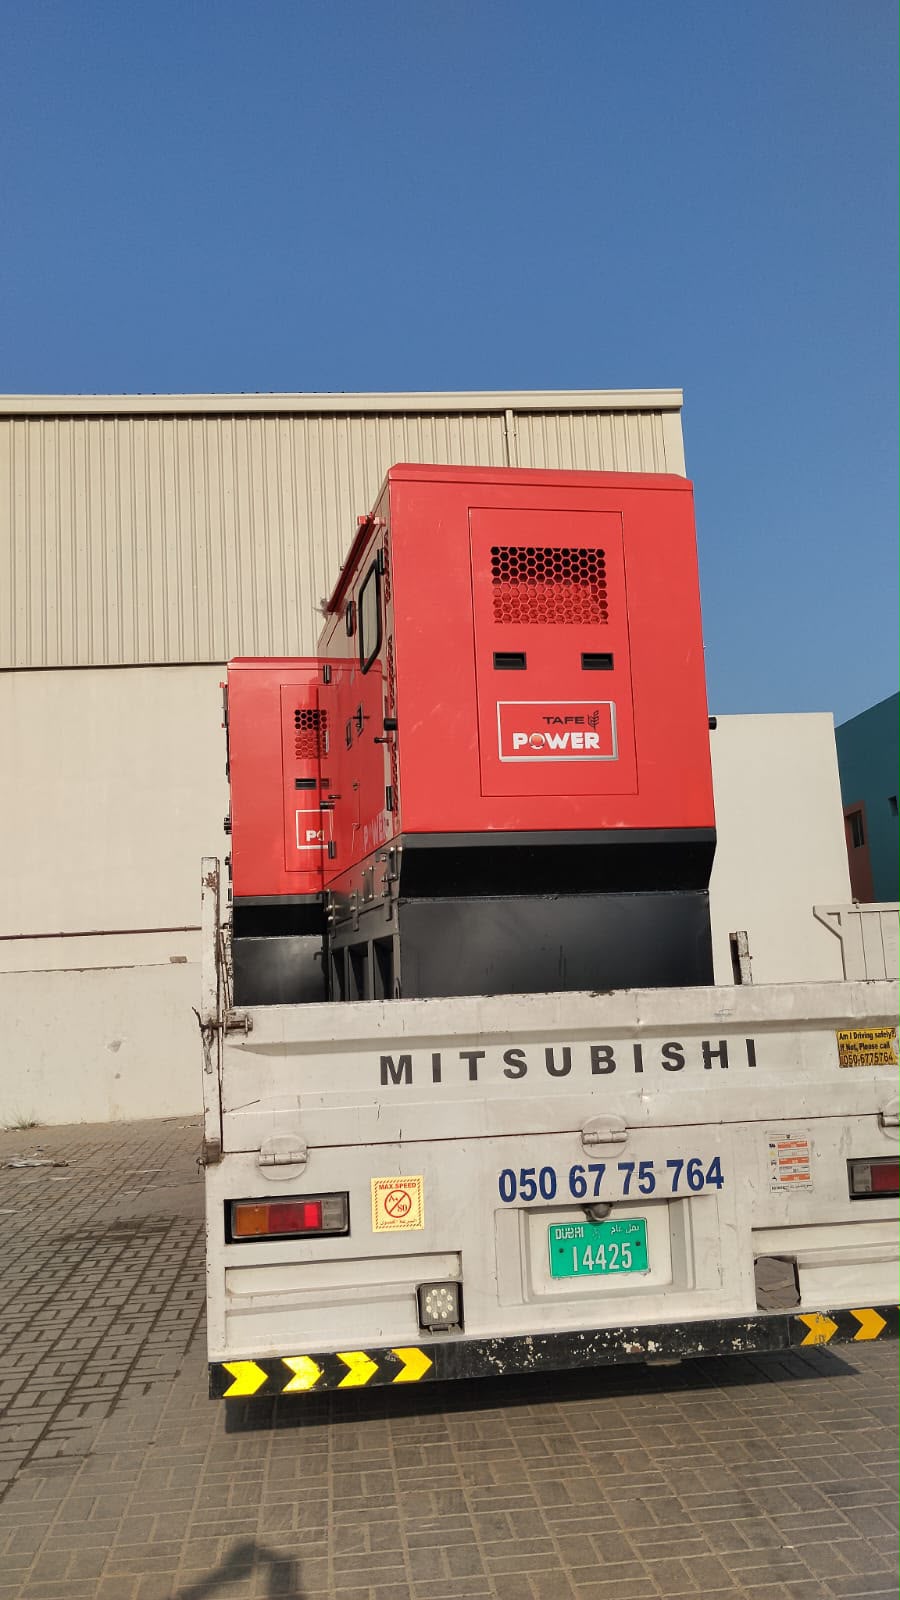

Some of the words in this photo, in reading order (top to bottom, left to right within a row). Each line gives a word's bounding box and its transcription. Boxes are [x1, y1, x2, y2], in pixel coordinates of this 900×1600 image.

[542, 716, 585, 725] TAFE
[512, 732, 600, 750] POWER
[854, 1032, 873, 1040] Driving
[380, 1038, 757, 1085] MITSUBISHI
[499, 1167, 557, 1203] 050
[569, 1163, 606, 1198] 67
[617, 1160, 656, 1195] 75
[666, 1156, 724, 1192] 764
[573, 1242, 632, 1272] 14425
